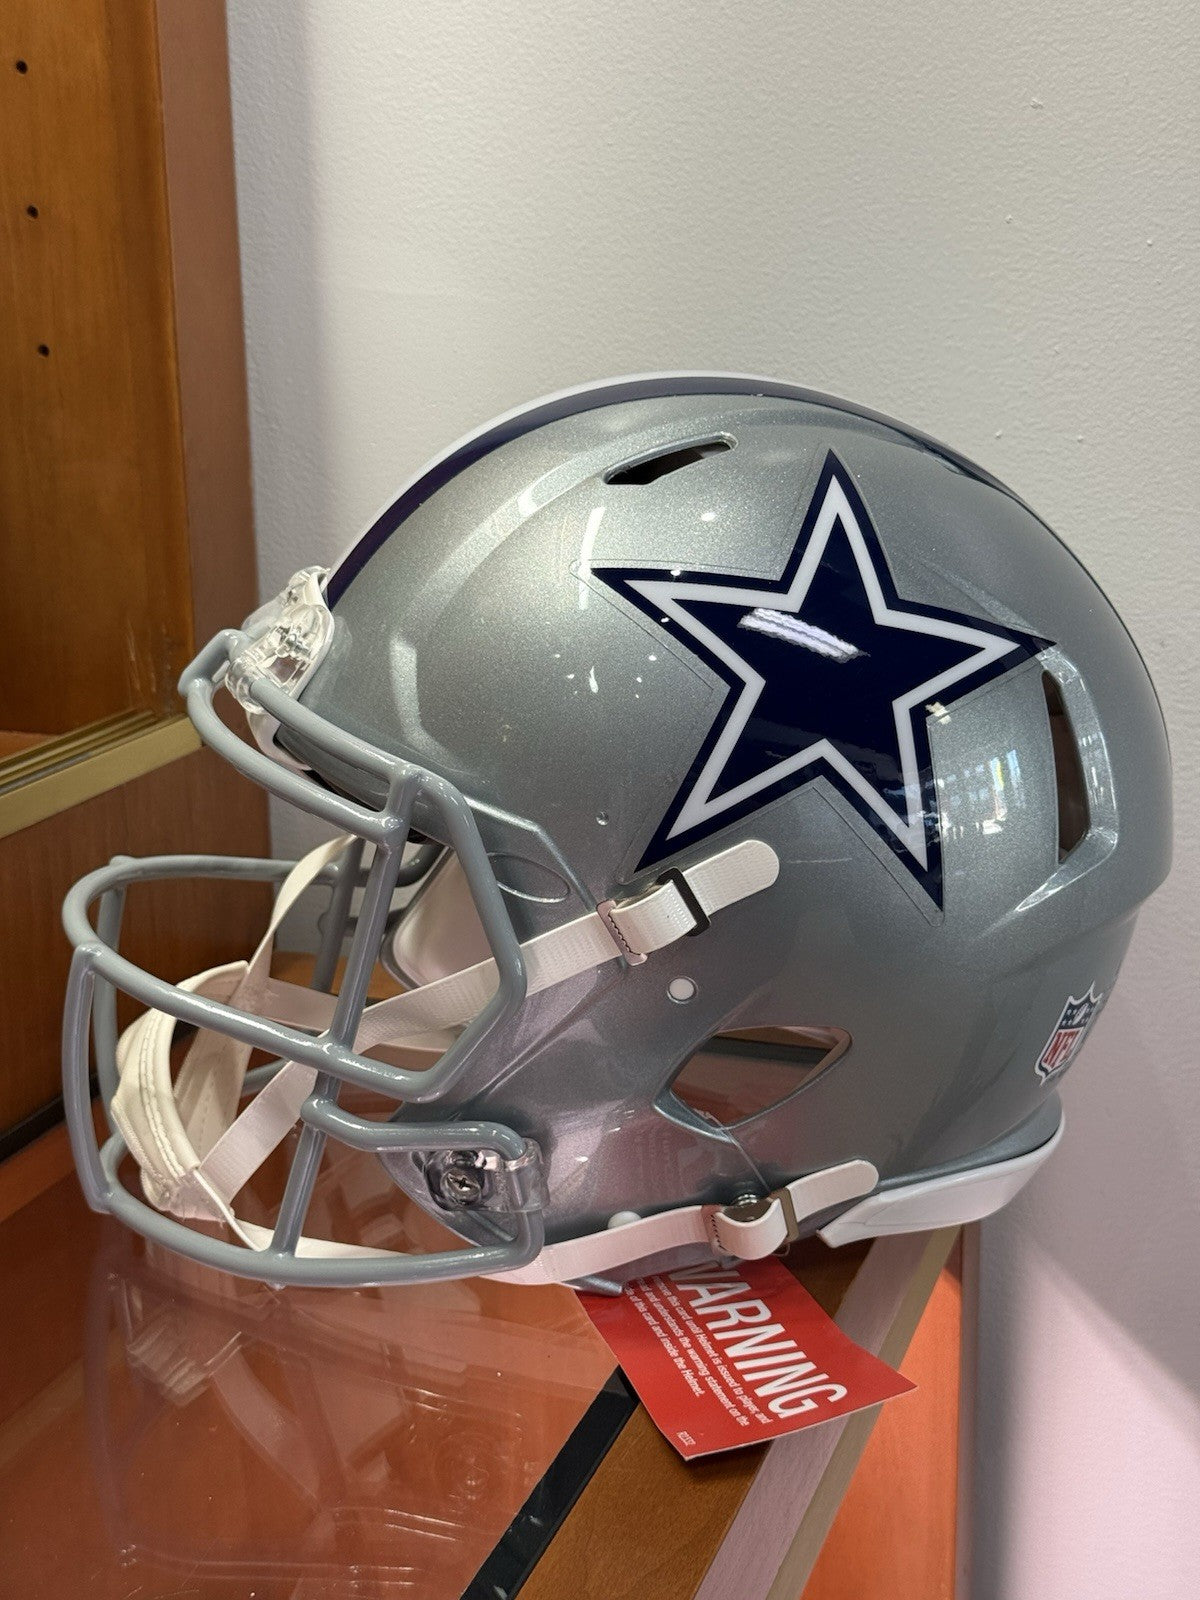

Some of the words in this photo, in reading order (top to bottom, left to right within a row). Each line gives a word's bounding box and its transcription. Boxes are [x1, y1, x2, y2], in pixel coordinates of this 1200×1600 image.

[629, 1295, 642, 1303] of
[634, 1301, 648, 1313] this
[641, 1312, 660, 1326] card
[651, 1325, 668, 1338] and
[660, 1336, 680, 1357] inside
[645, 1291, 661, 1303] and
[653, 1301, 684, 1337] understands
[678, 1336, 692, 1349] the
[687, 1348, 711, 1376] warning
[705, 1375, 736, 1410] statement
[729, 1407, 742, 1418] on
[736, 1415, 750, 1427] the
[667, 1295, 680, 1307] this
[675, 1306, 693, 1320] card
[685, 1319, 704, 1335] until
[696, 1333, 719, 1358] Helmet
[711, 1357, 723, 1366] is
[717, 1364, 741, 1388] issued
[733, 1386, 744, 1396] to
[755, 1412, 774, 1424] and
[673, 1356, 687, 1370] the
